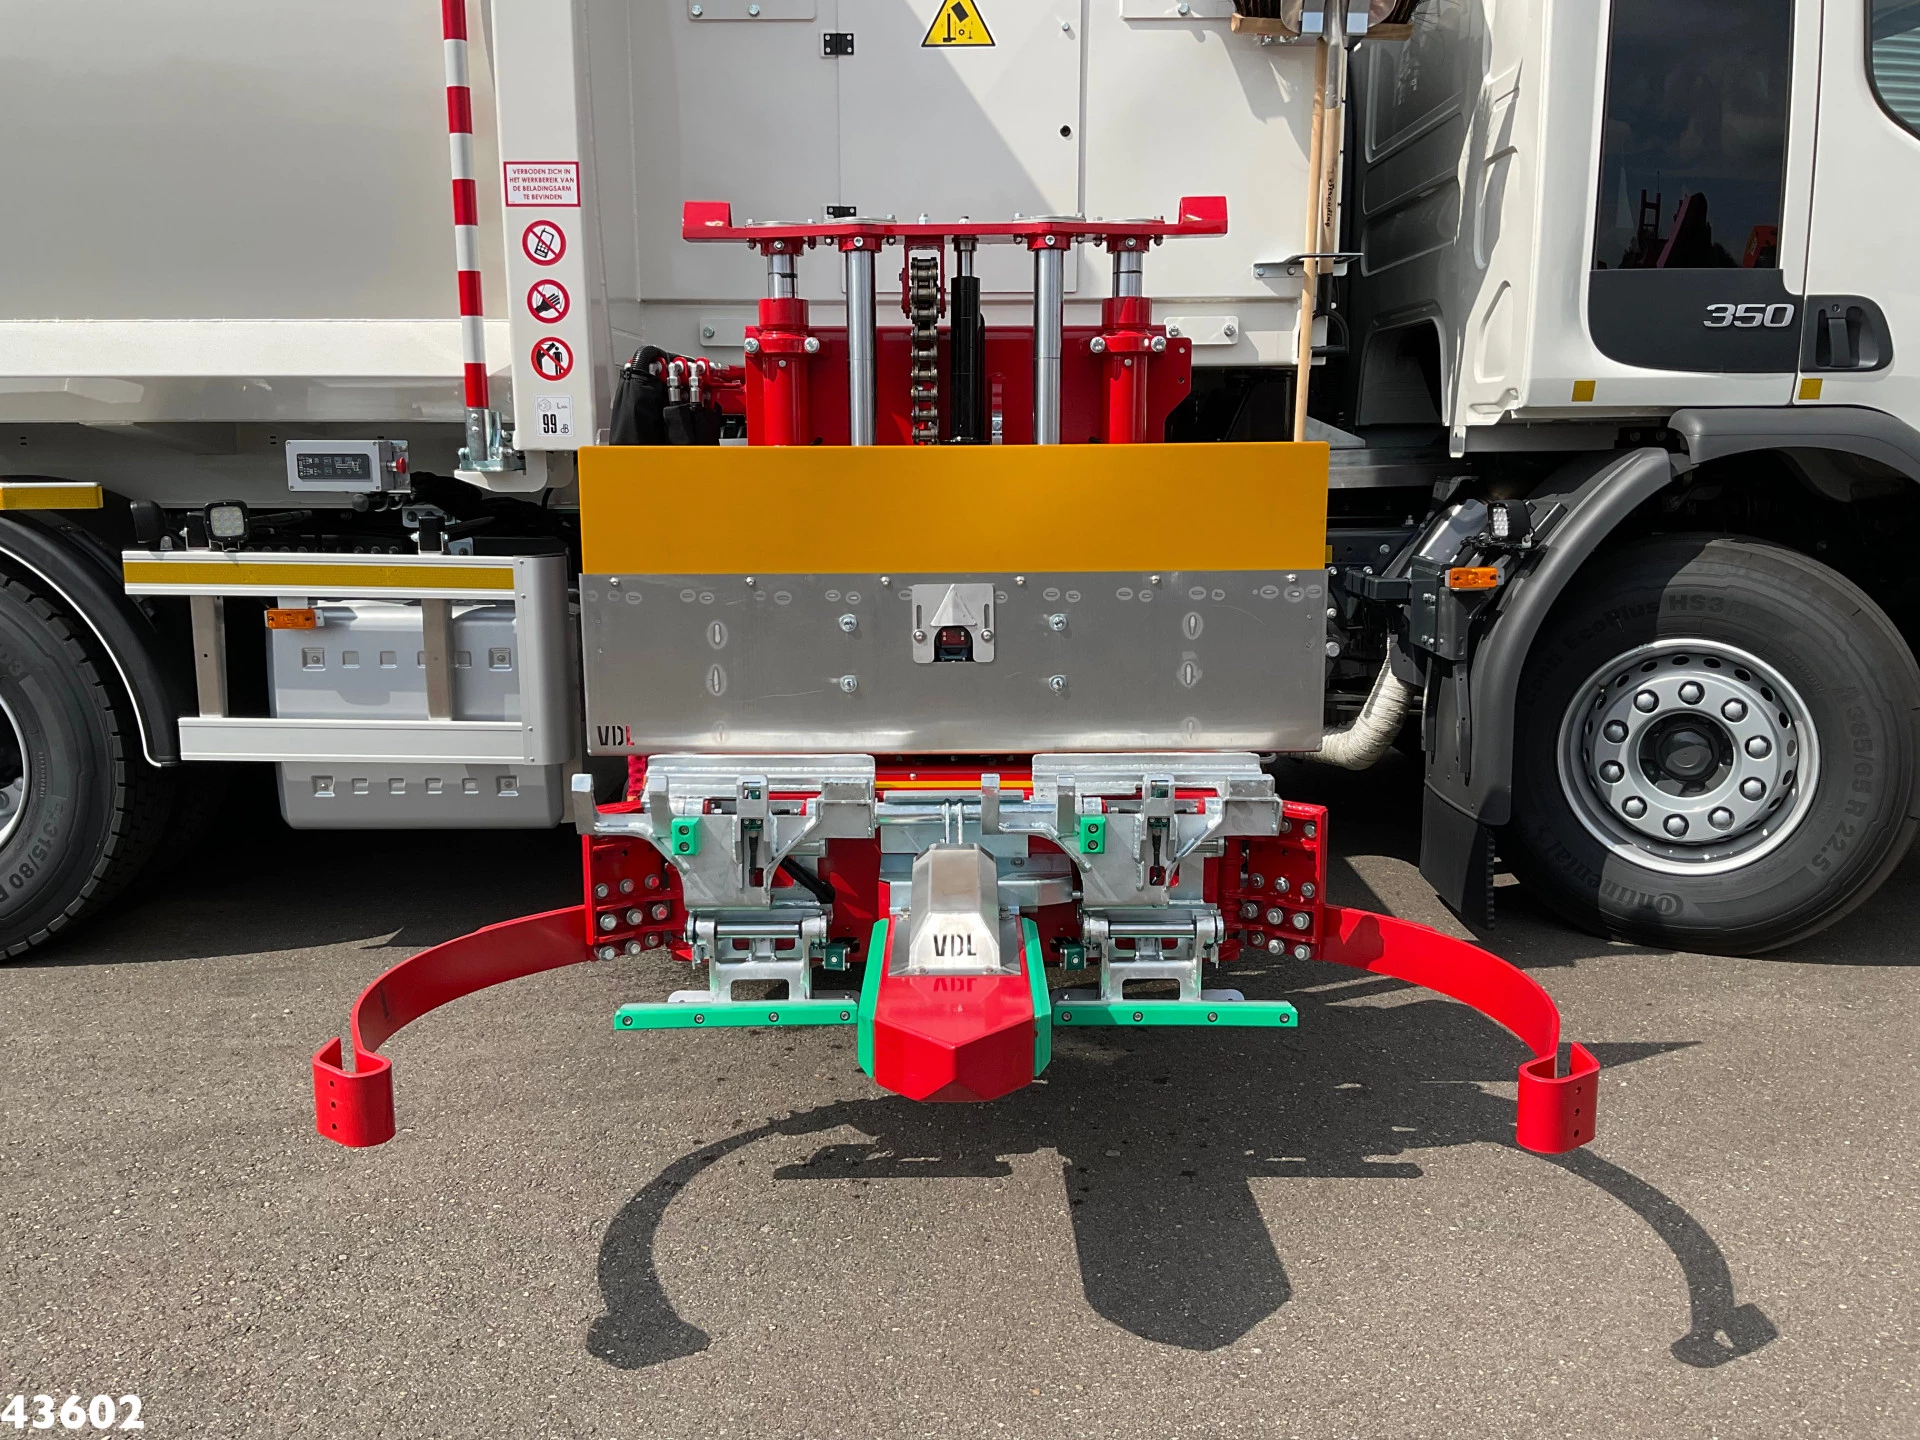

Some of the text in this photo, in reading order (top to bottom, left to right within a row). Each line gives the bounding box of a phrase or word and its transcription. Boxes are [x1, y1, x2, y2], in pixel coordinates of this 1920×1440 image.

[1703, 303, 1795, 328] 350
[542, 413, 558, 434] 99
[1669, 594, 1726, 614] HS3
[596, 725, 635, 746] VDL
[1811, 820, 1856, 873] 22.5
[933, 933, 977, 956] VDL
